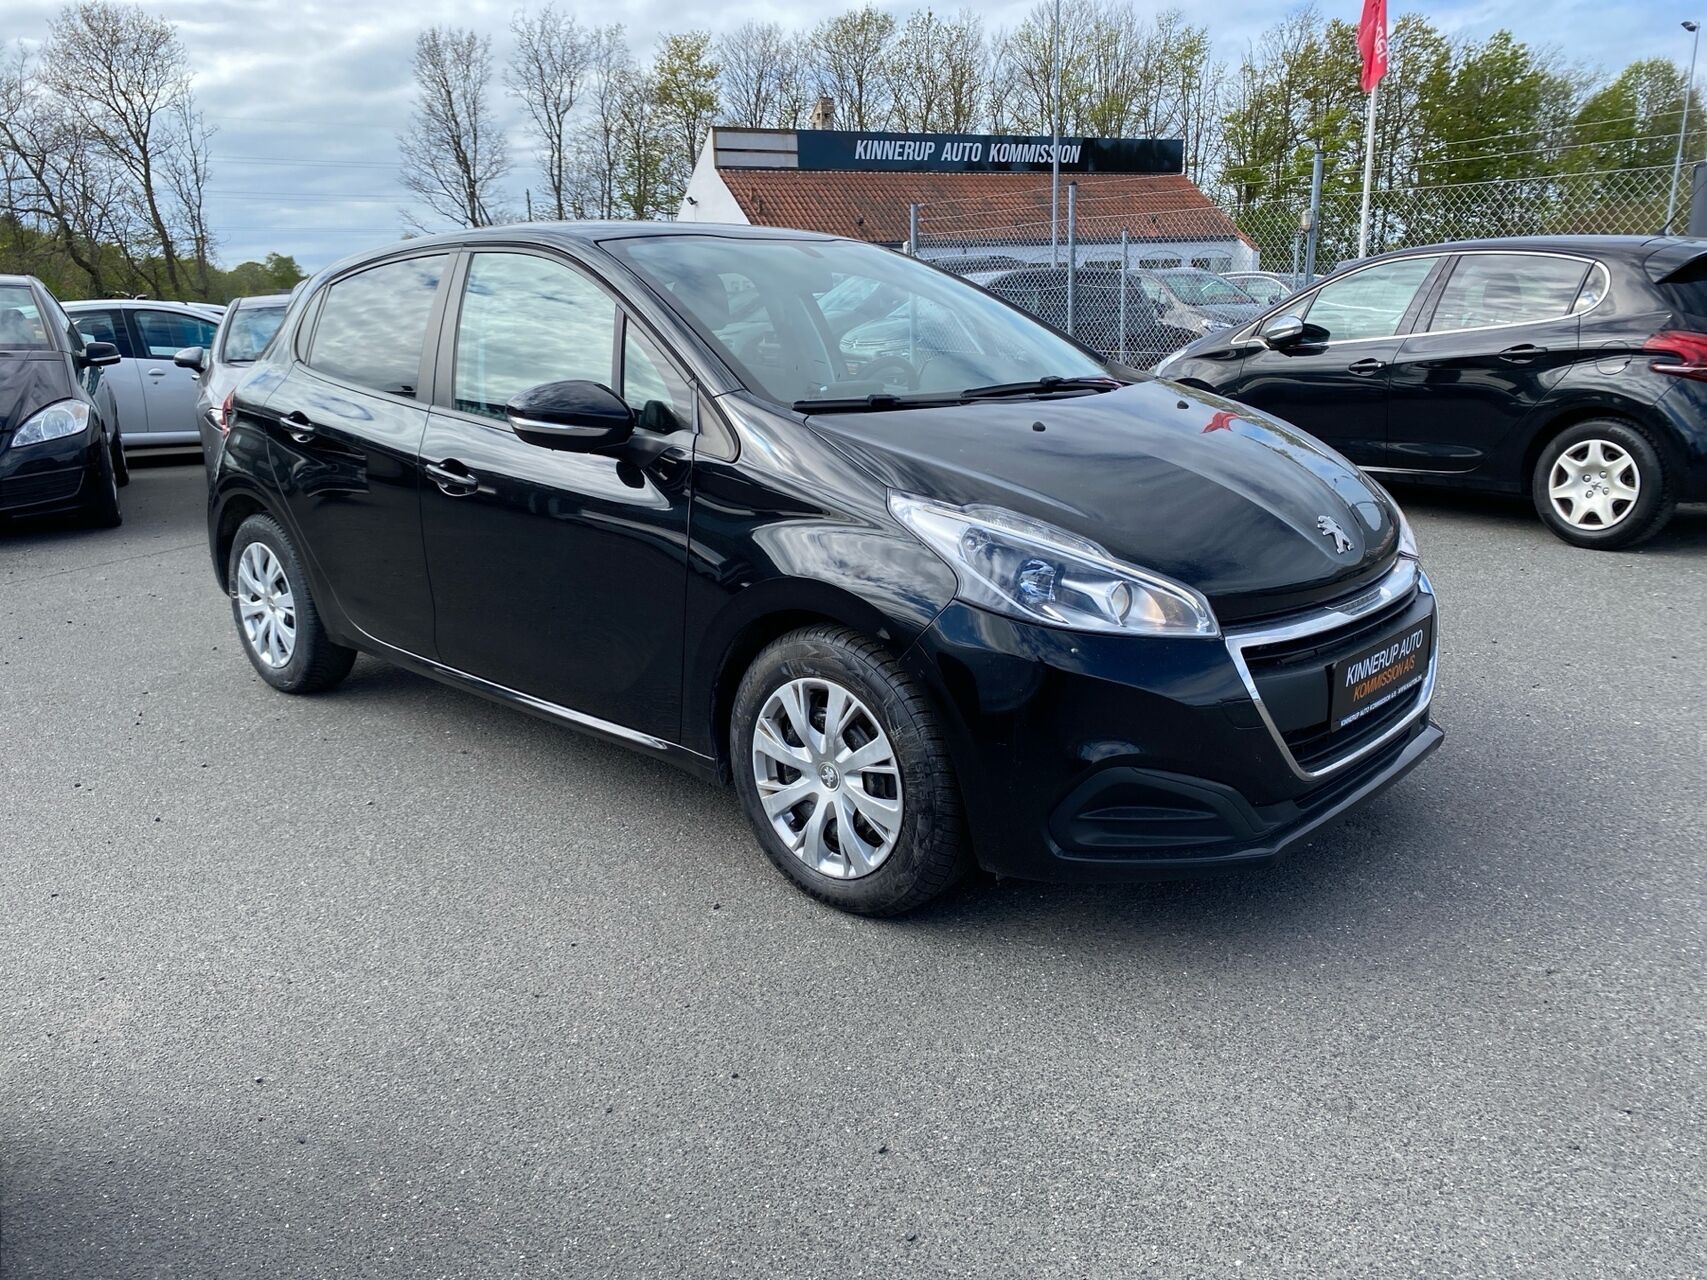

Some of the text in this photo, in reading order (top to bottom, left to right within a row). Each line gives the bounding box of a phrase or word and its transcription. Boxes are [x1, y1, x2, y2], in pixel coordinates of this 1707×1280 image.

[855, 139, 936, 161] KINNERUP
[941, 142, 983, 162] AUTO
[1345, 643, 1399, 687] KINNERUP
[1398, 629, 1423, 659] AUTO
[1353, 661, 1404, 701] KOMMISSION
